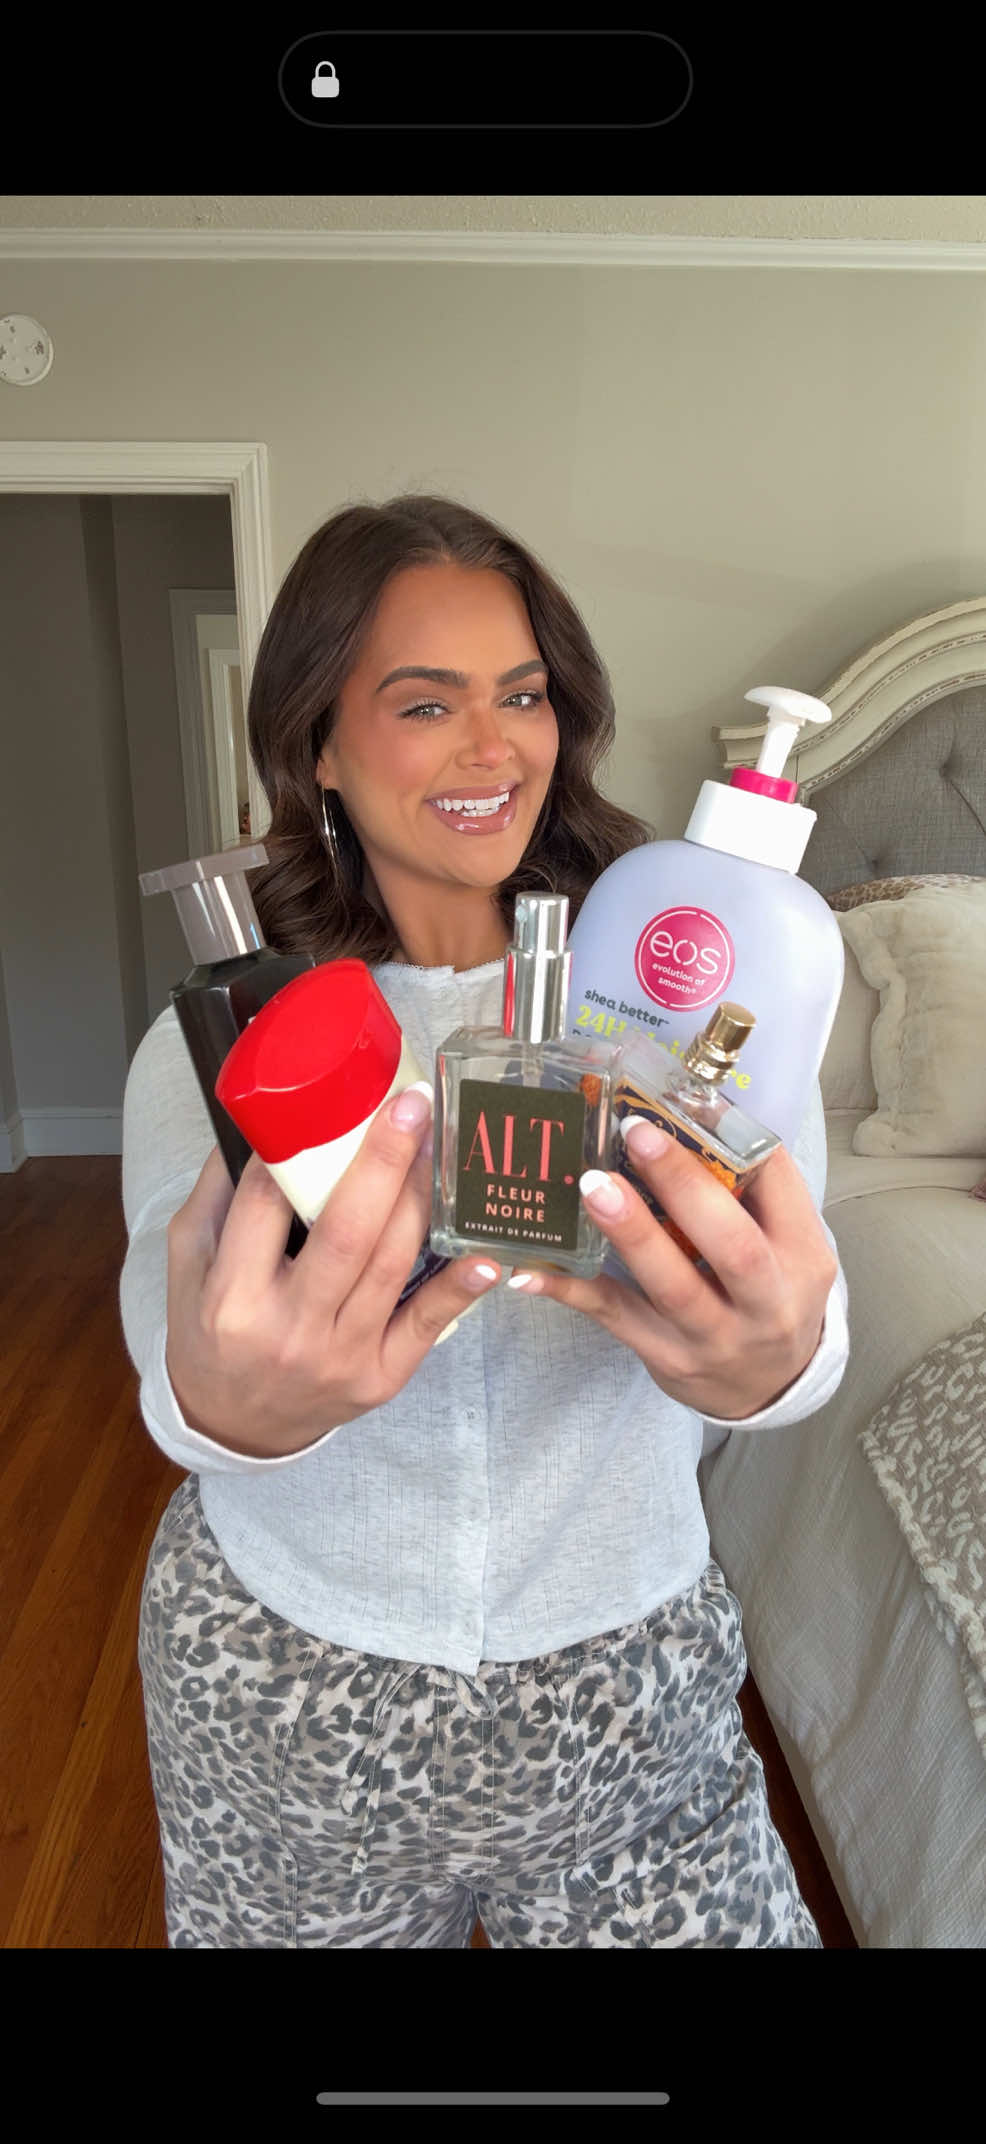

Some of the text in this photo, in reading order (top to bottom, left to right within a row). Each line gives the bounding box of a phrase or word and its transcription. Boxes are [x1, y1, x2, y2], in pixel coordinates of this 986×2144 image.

[650, 930, 722, 974] eos
[652, 963, 694, 983] evolution
[584, 990, 616, 1010] shea
[576, 1005, 627, 1038] 24H
[463, 1109, 575, 1184] ALT.
[486, 1183, 545, 1204] FLEUR
[485, 1201, 545, 1223] NOIRE
[465, 1221, 562, 1243] EXTRAIT DE PARFUM
